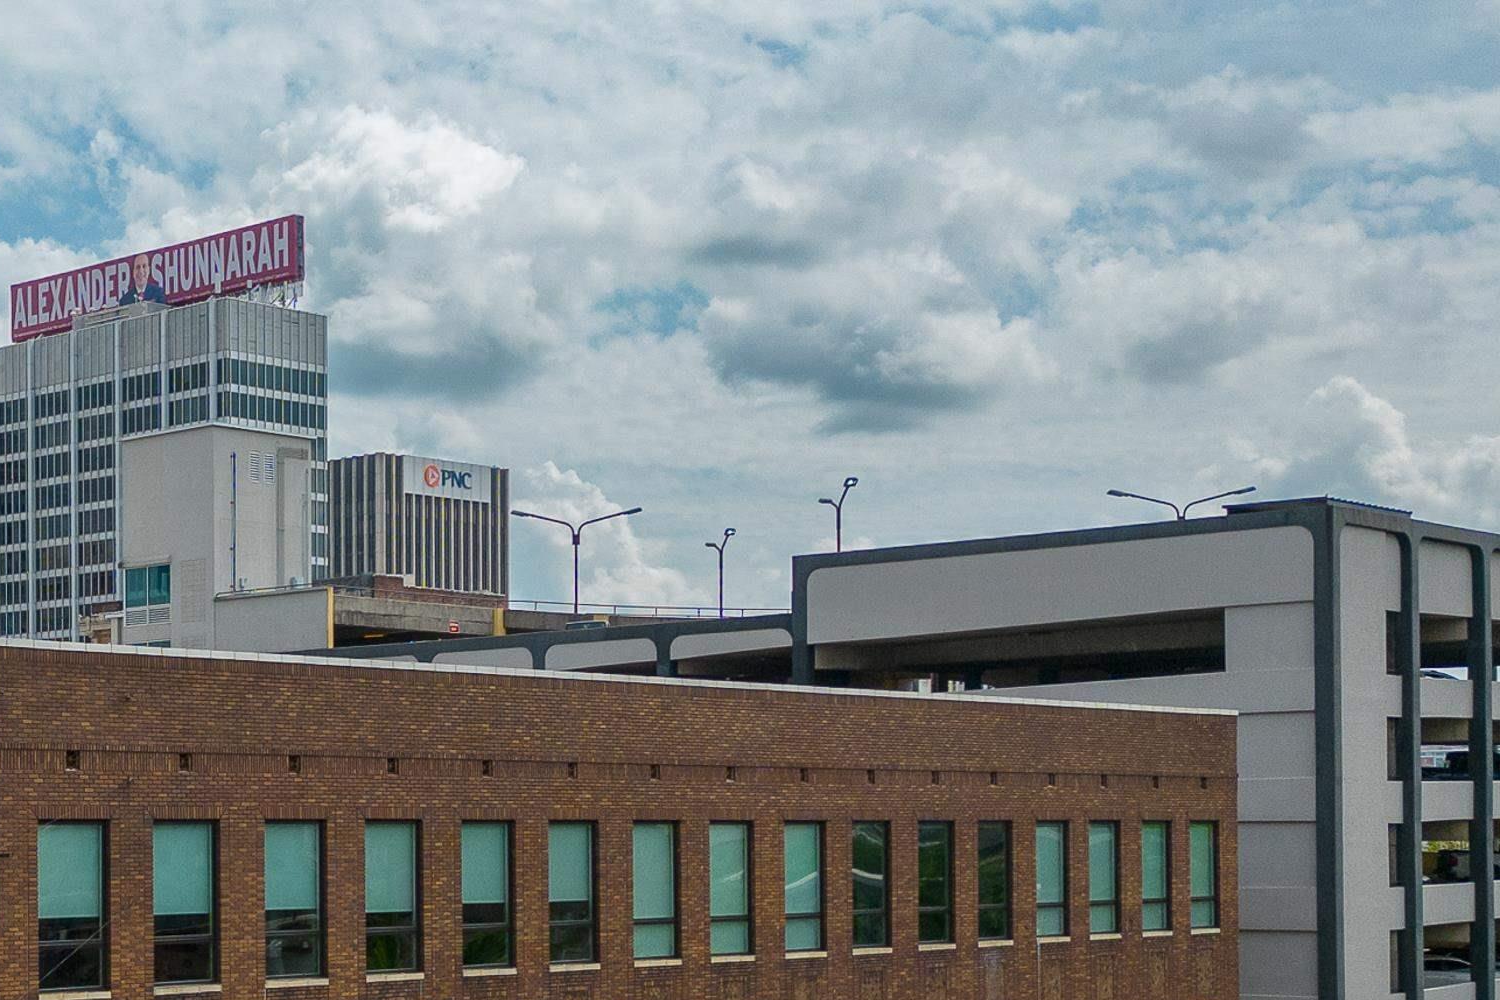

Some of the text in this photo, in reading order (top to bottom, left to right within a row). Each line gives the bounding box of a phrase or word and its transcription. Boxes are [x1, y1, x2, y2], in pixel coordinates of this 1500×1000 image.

[14, 221, 289, 329] ALEXANDER SHUNNARAH
[441, 469, 472, 489] PNC
